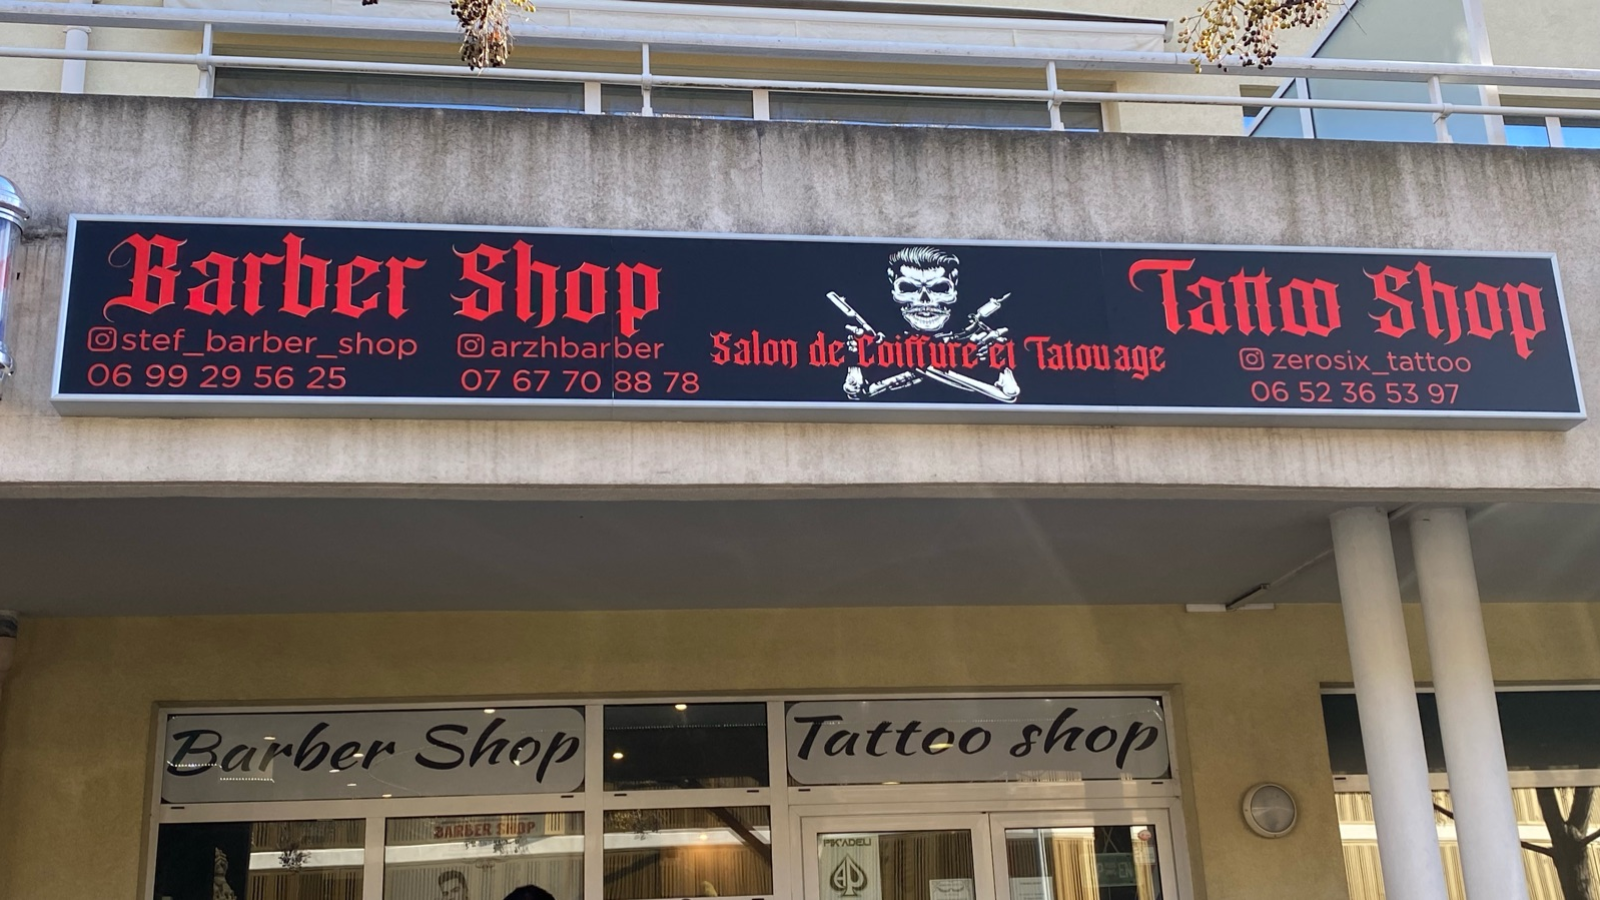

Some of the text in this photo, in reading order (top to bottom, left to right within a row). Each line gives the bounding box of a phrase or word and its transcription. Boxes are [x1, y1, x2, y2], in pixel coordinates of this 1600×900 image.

[104, 232, 662, 338] Barber Shop
[1128, 257, 1546, 360] Tattoo Shop
[121, 328, 418, 360] stef_barber_shop
[490, 335, 665, 361] arzhbarber
[710, 329, 1166, 380] Salon de Coiffure et Tatouage
[87, 363, 347, 390] 06 99 29 56 25
[1273, 349, 1471, 375] zerosix_tattoo
[460, 368, 701, 395] 07 67 70 88 78
[1250, 381, 1459, 405] 06 52 36 53 97
[167, 718, 580, 784] Barber Shop
[793, 707, 1160, 770] Tattoo shop
[434, 820, 536, 838] BARBER SHOP
